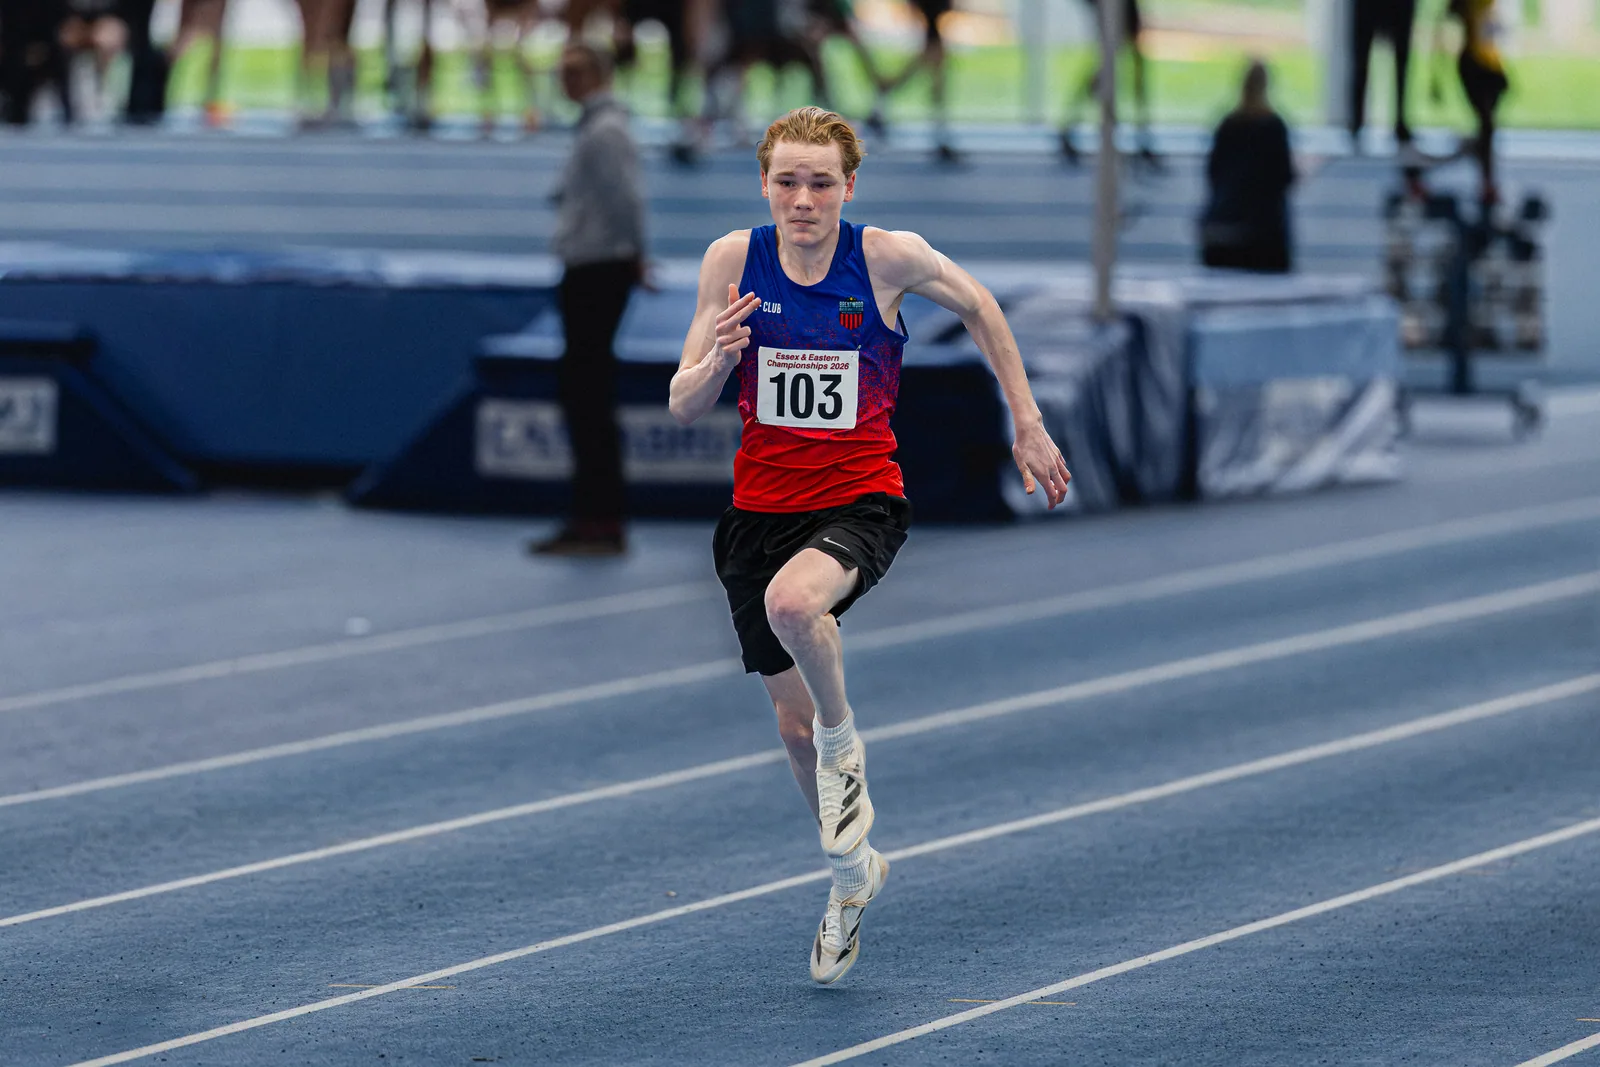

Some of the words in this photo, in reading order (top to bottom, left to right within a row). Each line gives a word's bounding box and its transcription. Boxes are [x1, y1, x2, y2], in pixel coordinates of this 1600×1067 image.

[763, 301, 781, 313] CLUB
[775, 352, 799, 360] Essex
[808, 353, 840, 361] Eastern
[767, 359, 828, 370] Championships
[830, 362, 849, 370] 2026
[769, 372, 843, 420] 103
